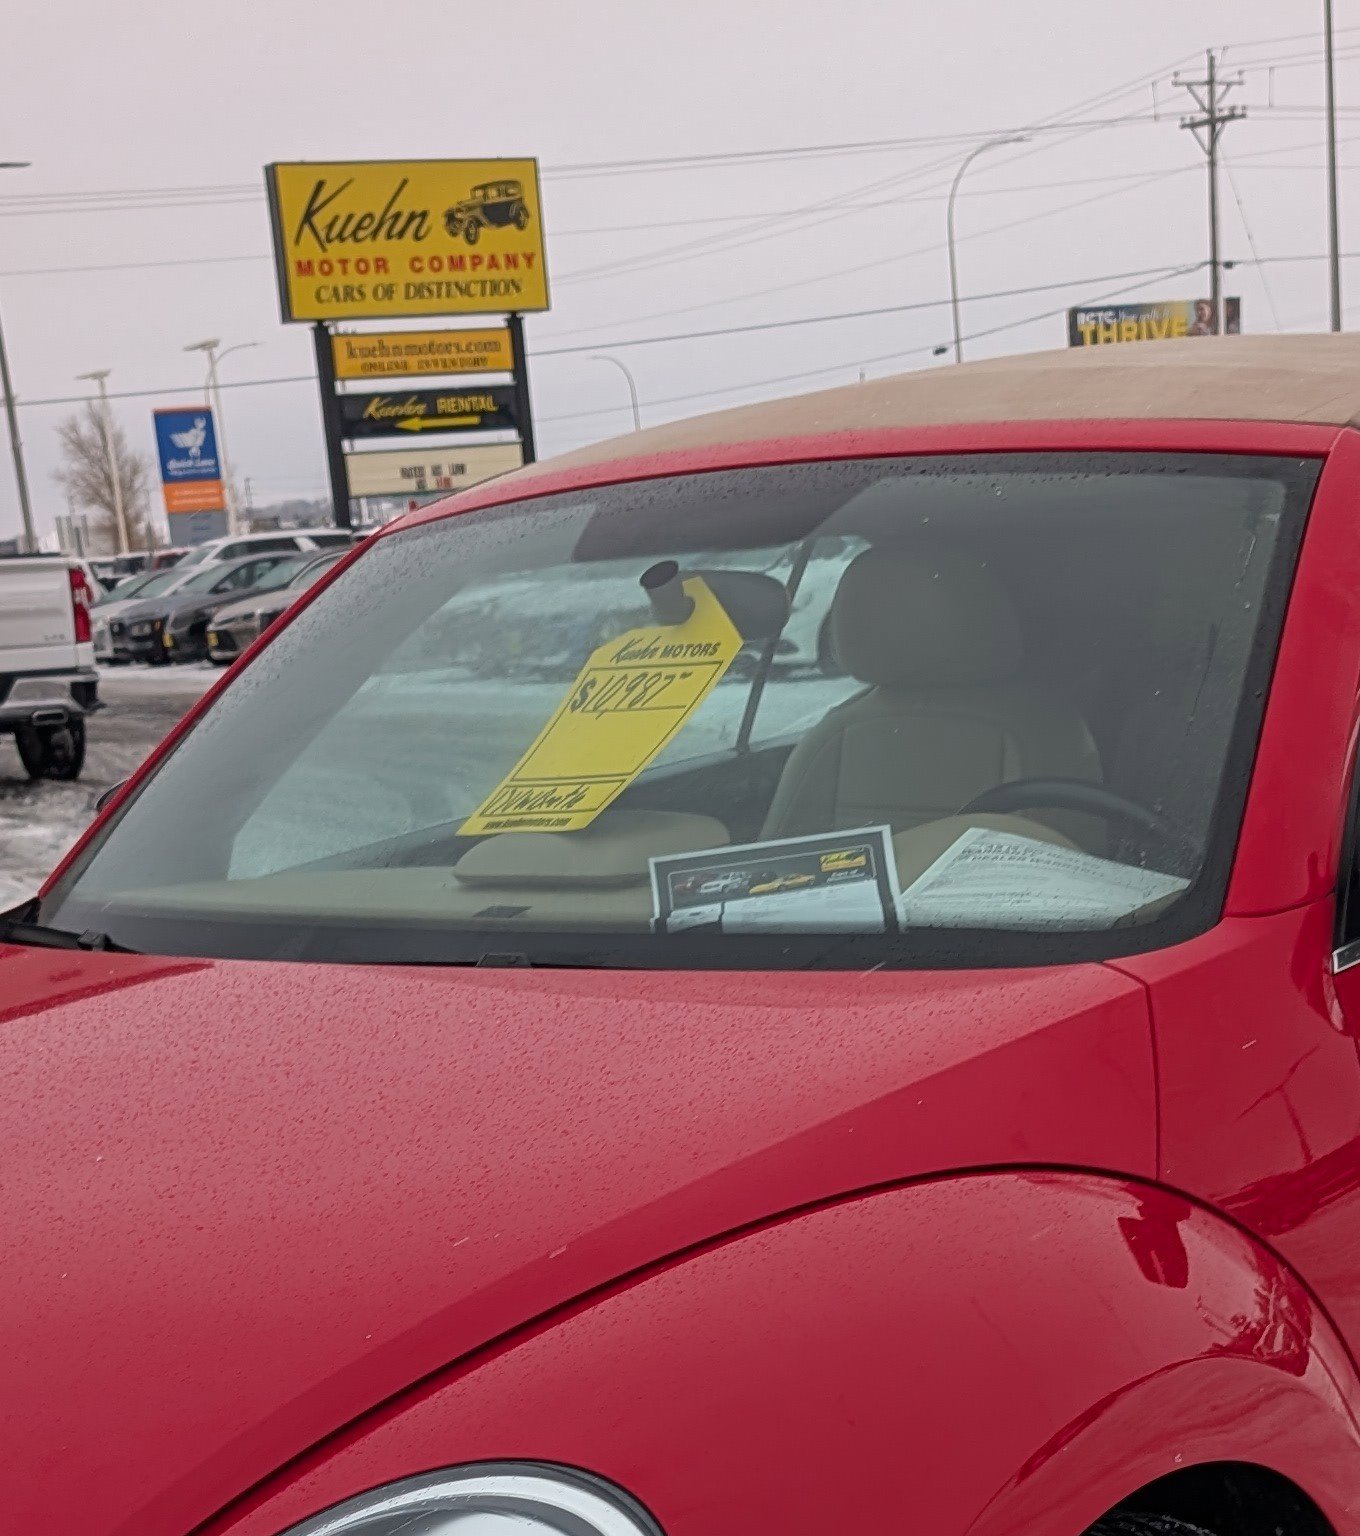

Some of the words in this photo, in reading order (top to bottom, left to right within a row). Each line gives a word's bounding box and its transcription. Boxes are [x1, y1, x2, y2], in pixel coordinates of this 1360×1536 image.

[294, 176, 432, 253] Kuehn
[295, 255, 390, 277] MOTOR
[408, 251, 537, 275] COMPANY
[314, 282, 367, 305] CARS
[372, 280, 396, 301] OF
[404, 278, 523, 300] DISTINCTION
[1077, 314, 1189, 346] THRIVE
[660, 641, 721, 659] MOTORS
